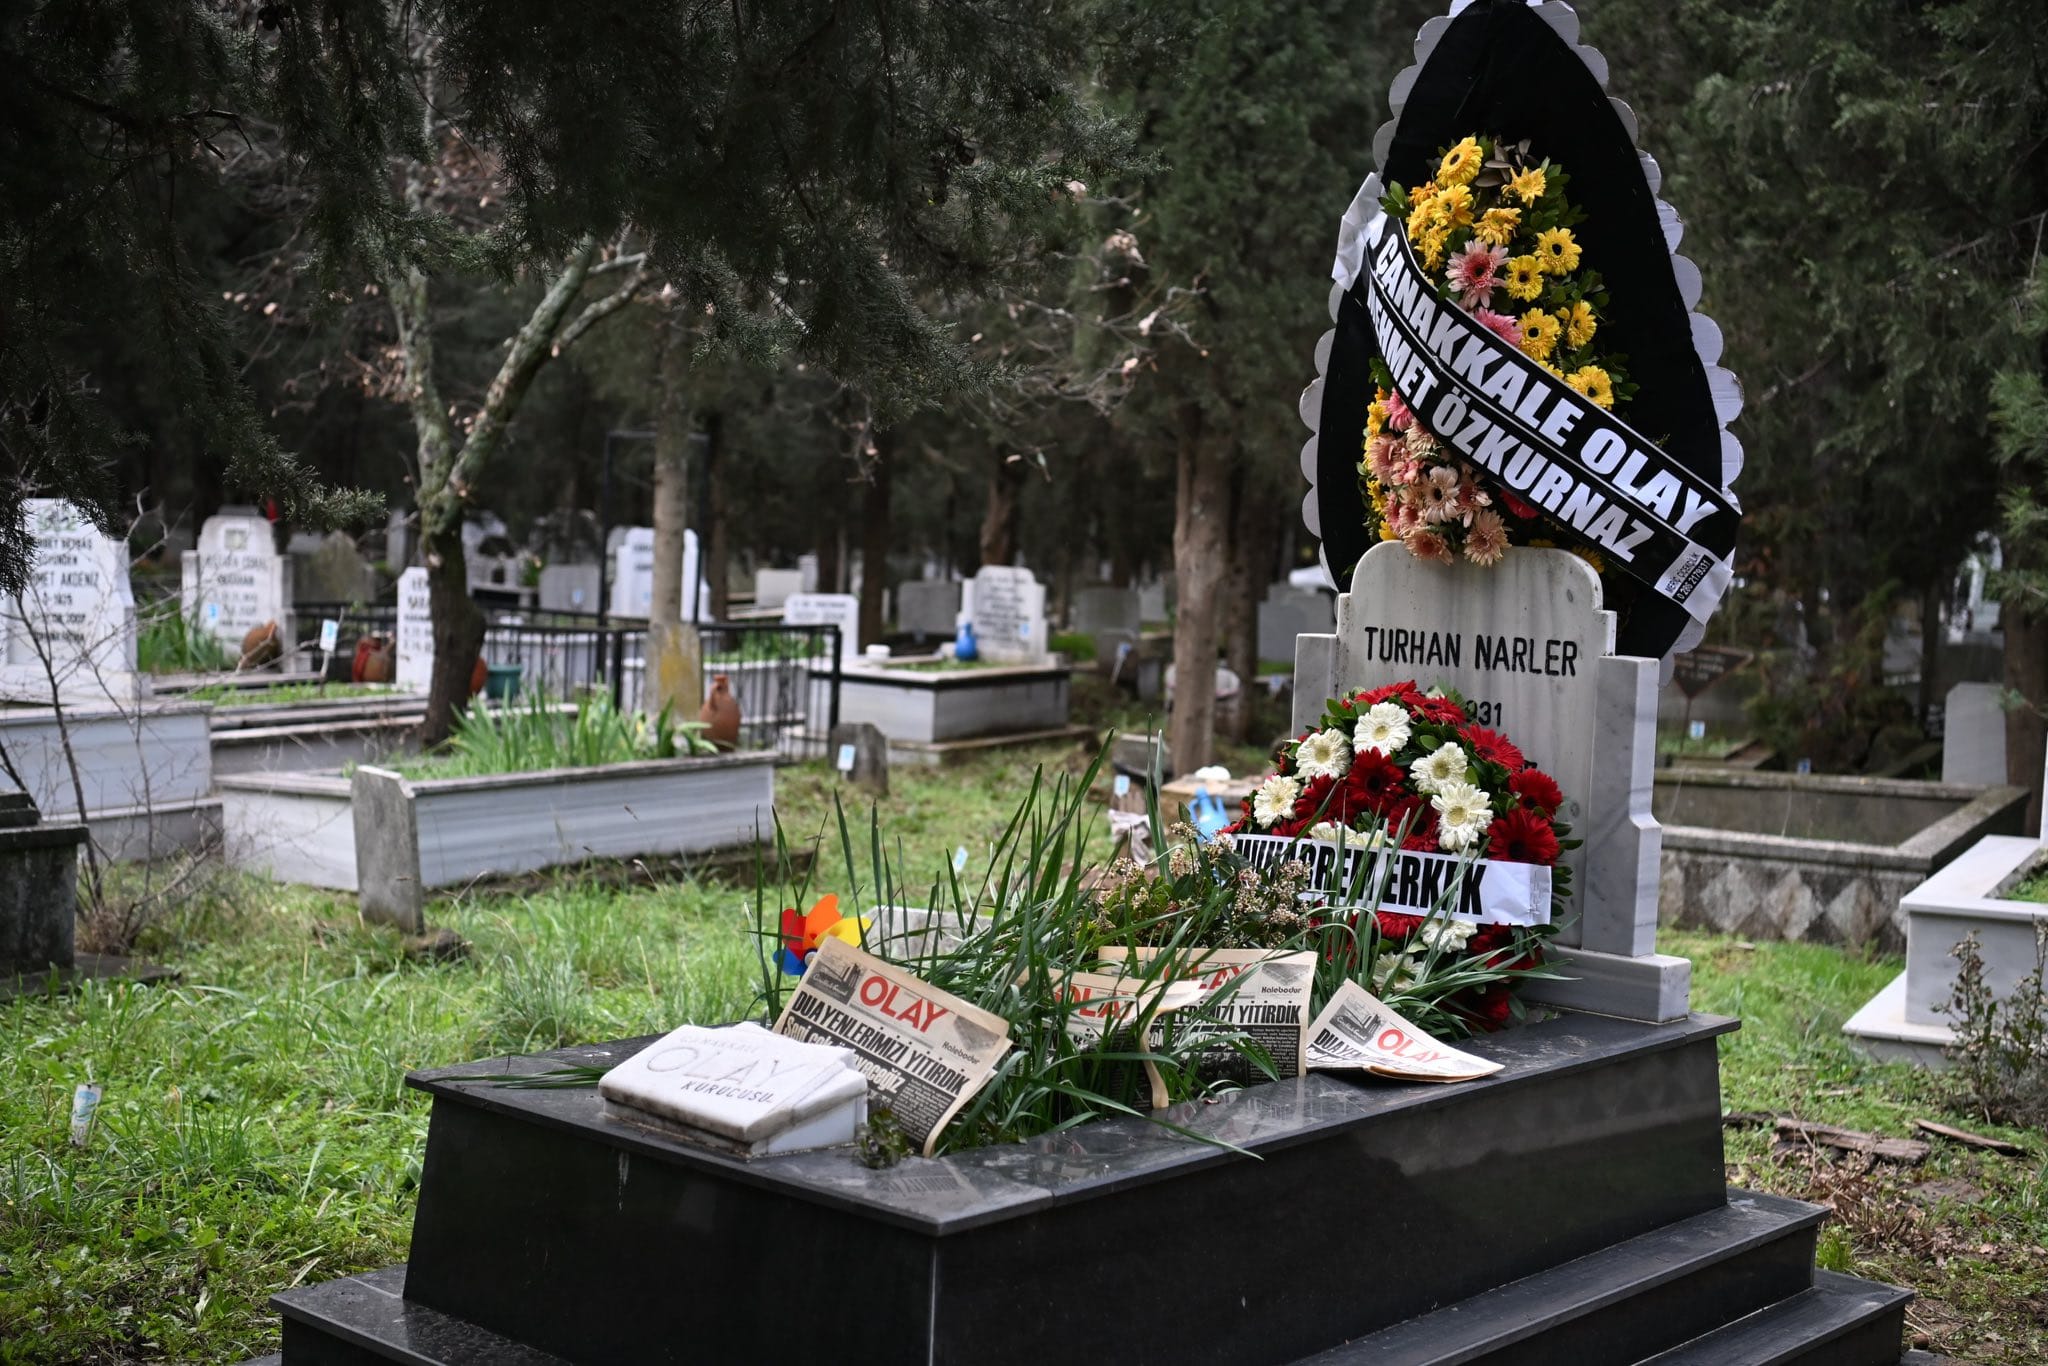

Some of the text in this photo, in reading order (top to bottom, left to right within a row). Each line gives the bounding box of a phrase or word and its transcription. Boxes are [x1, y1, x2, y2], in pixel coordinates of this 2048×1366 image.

[1367, 276, 1655, 563] MEHMET ÖZKURNAZ
[1580, 427, 1719, 535] OLAY
[1364, 626, 1578, 677] TURHAN NARLER
[1466, 700, 1502, 728] 931
[1382, 853, 1487, 916] ERKEK
[860, 975, 949, 1033] OLAY
[1238, 1001, 1301, 1025] YİTİRDİK
[791, 990, 970, 1096] DUAYENLERİMİZİ YİTİRDİK
[1377, 1028, 1449, 1063] OLAY
[681, 1080, 774, 1103] KURUCUSU
